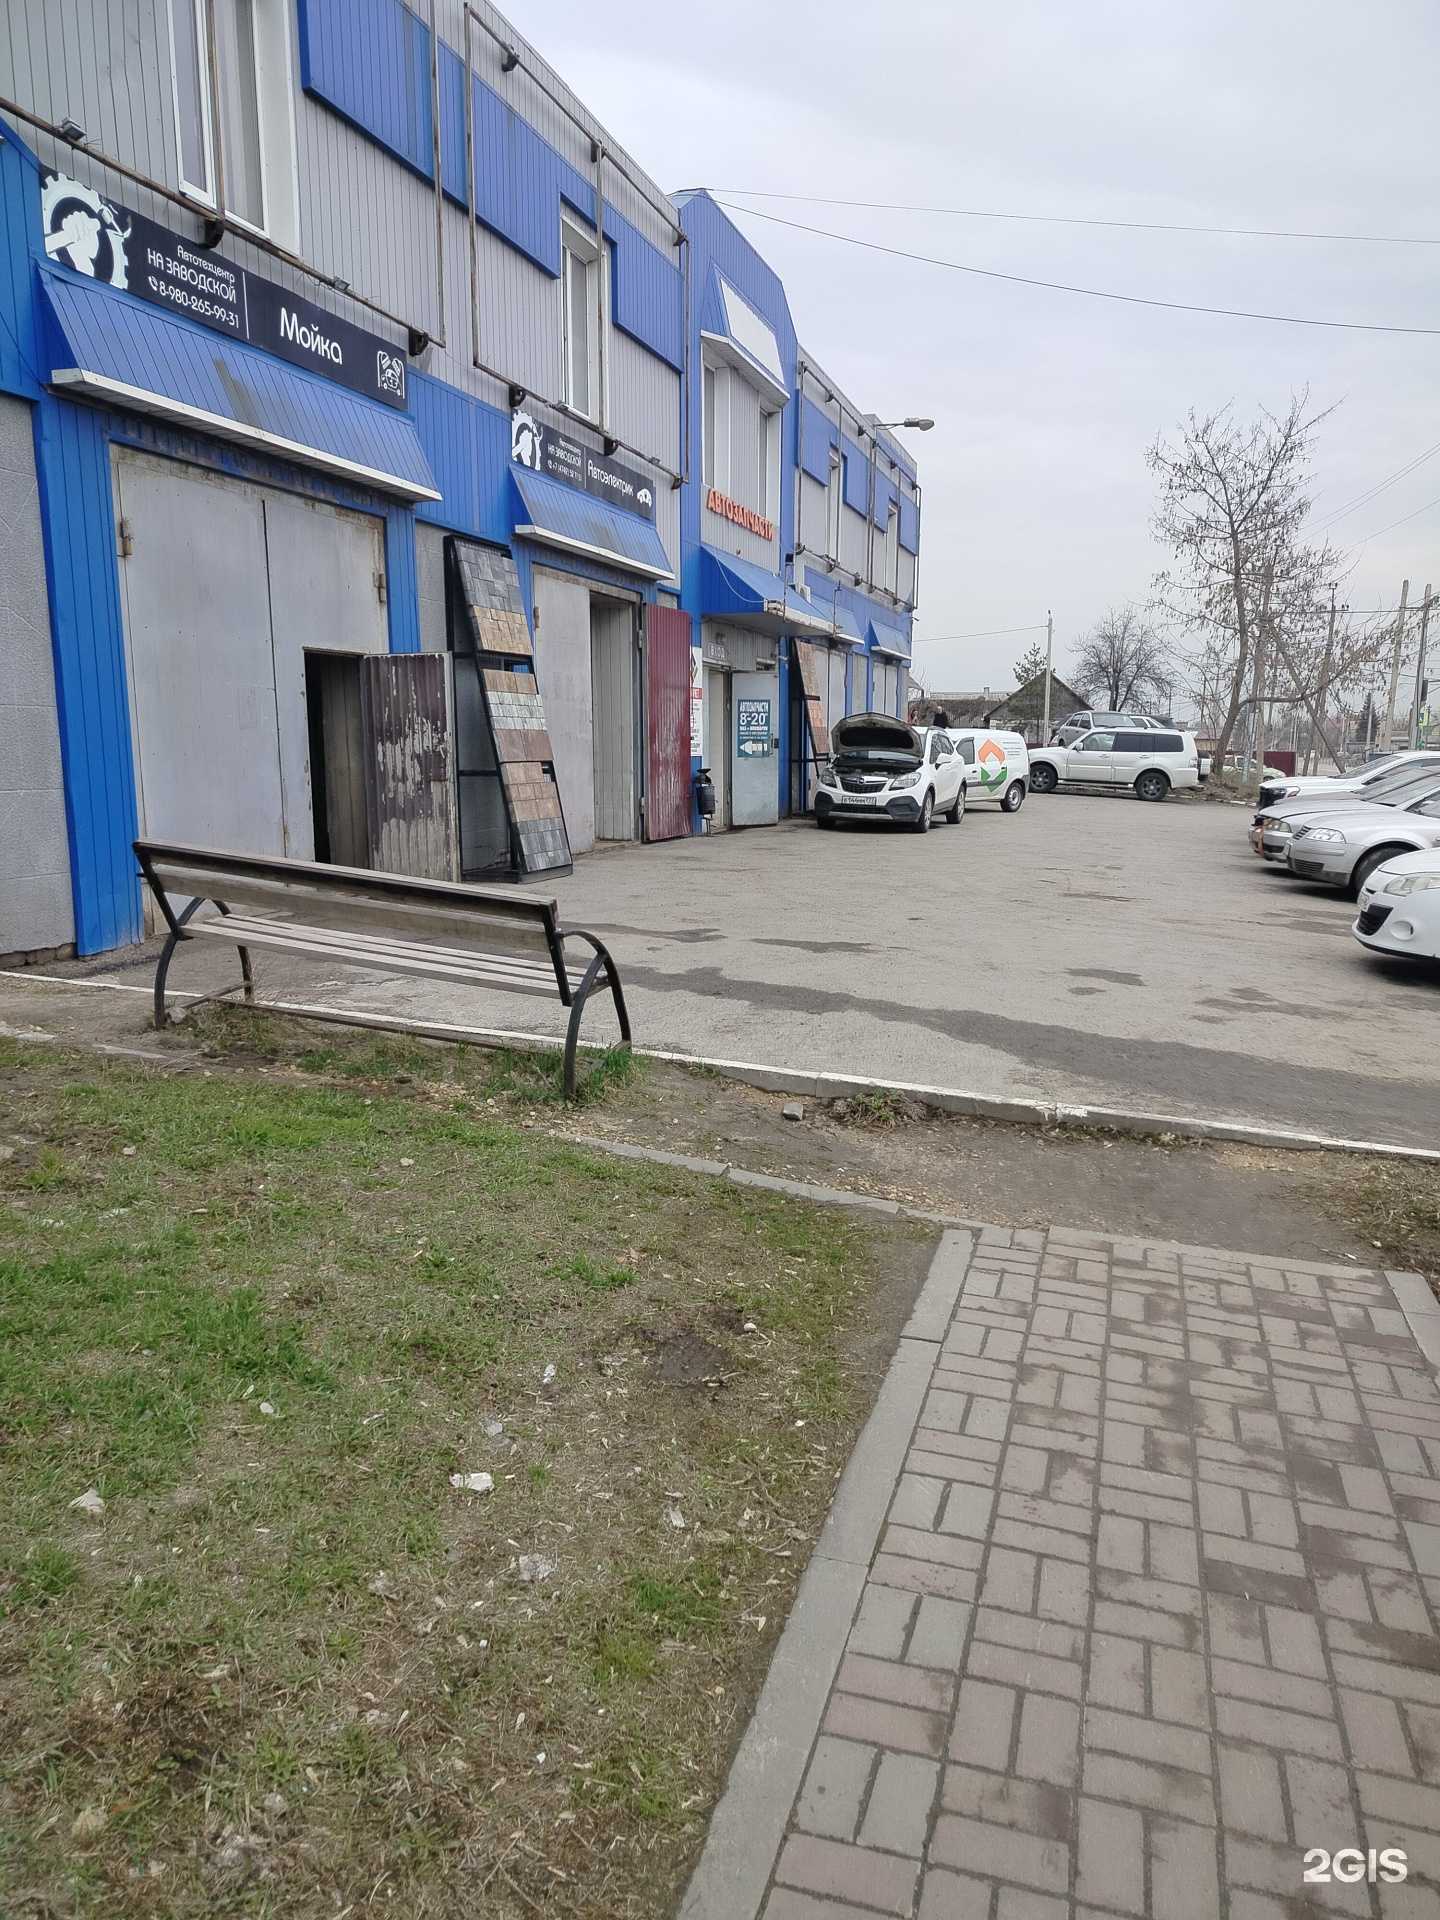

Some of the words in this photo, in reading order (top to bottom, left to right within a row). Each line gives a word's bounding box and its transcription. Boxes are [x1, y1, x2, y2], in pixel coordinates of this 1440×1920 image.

[147, 247, 165, 271] НА
[165, 257, 237, 304] ЗАВОДСКОЙ
[177, 244, 235, 284] Автотехцентр
[159, 280, 239, 329] 8-980-265-99-31
[280, 307, 343, 365] Мойка
[587, 459, 634, 497] Автоэлектрик
[706, 488, 775, 542] АВТОЗАПЧАСТИ
